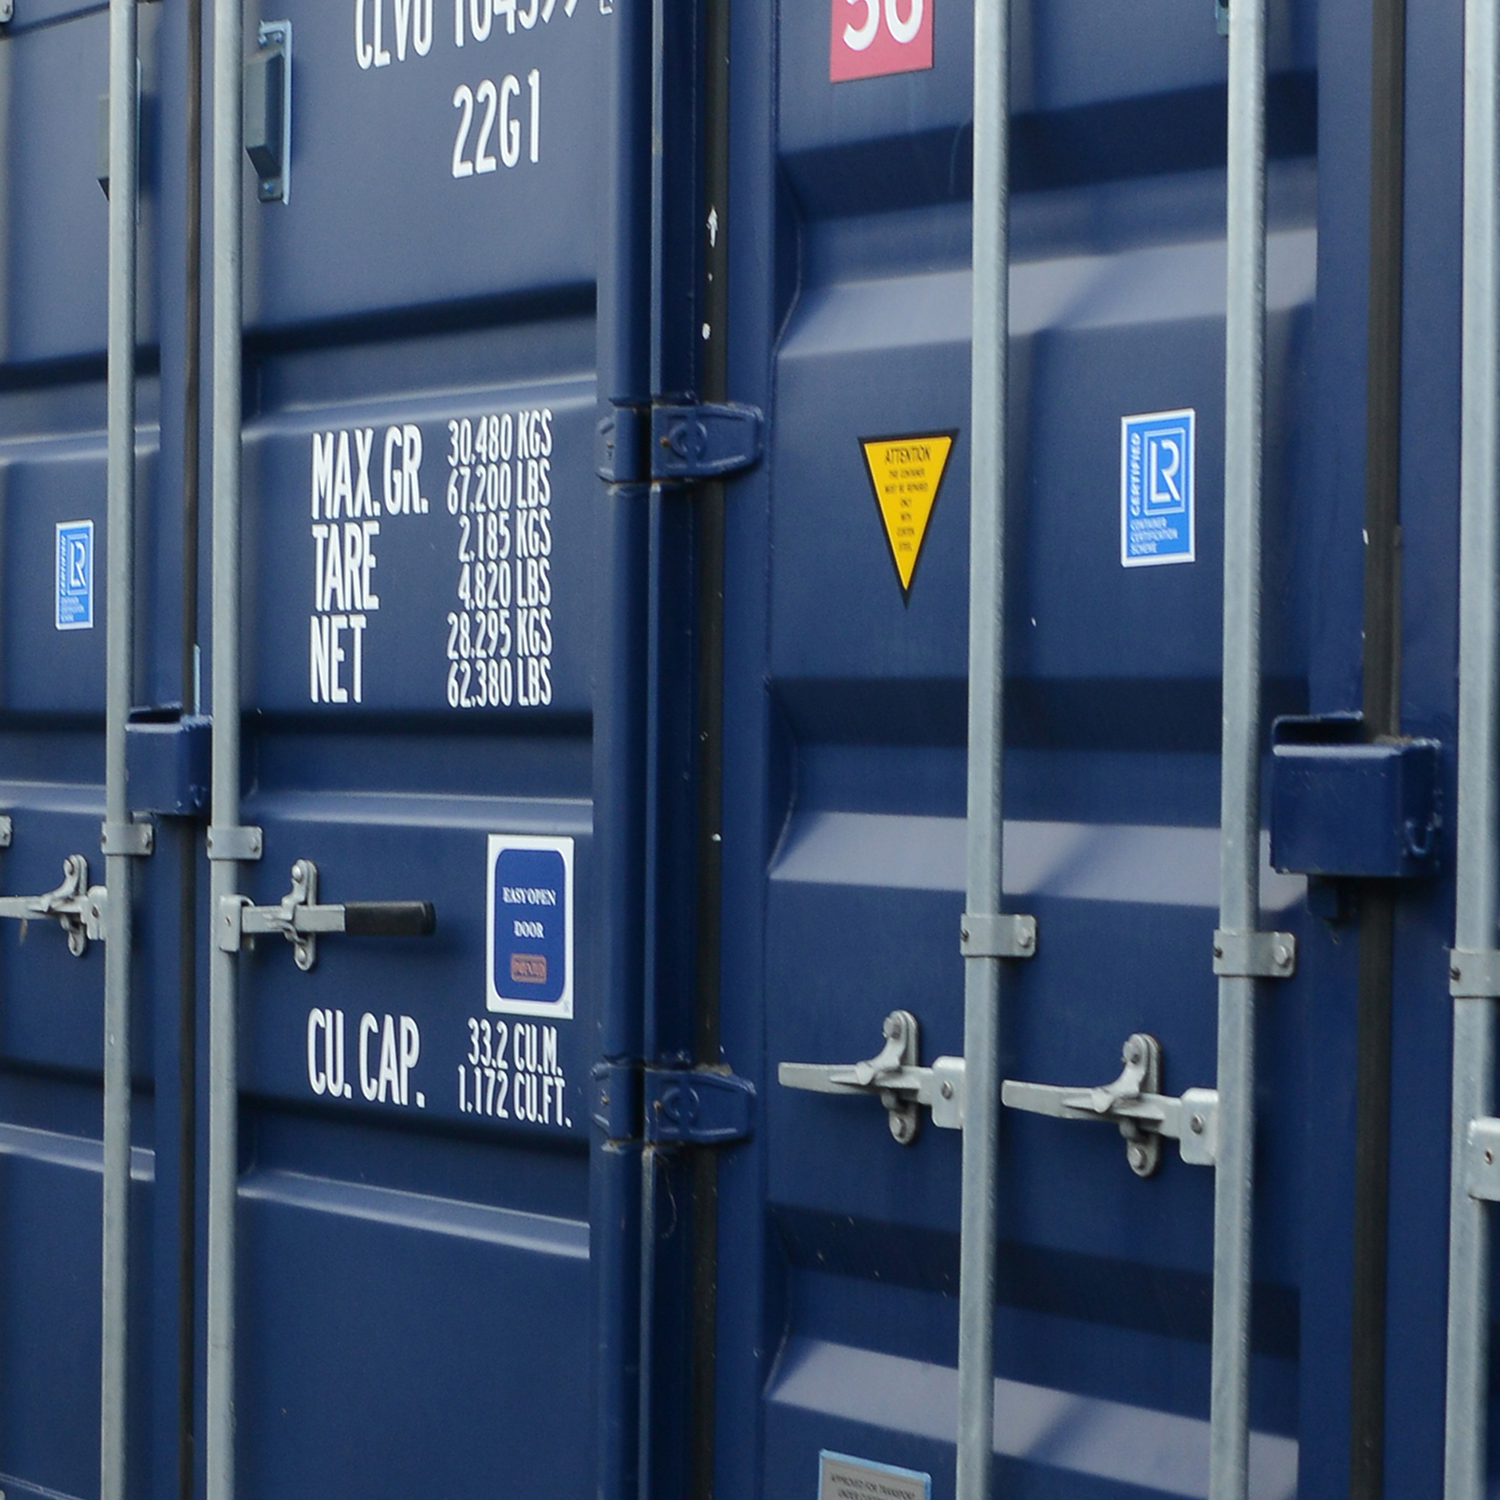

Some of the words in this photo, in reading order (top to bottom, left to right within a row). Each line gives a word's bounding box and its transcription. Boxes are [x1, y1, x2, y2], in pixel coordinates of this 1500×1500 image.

[354, 0, 434, 70] CLVU
[451, 68, 541, 179] 22G1
[447, 413, 513, 466] 30.480
[516, 409, 553, 460] KGS
[885, 445, 932, 465] ATTENTION
[447, 464, 512, 514] 67.200
[516, 458, 553, 509] LBS
[1130, 432, 1141, 517] CERTIFIED
[311, 520, 381, 612] TARE
[457, 514, 512, 564] 2.185
[515, 508, 553, 558] KGS
[457, 562, 512, 612] 4.820
[516, 558, 552, 609] LBS
[310, 614, 367, 704] NET
[447, 611, 512, 661] 28.295
[515, 608, 553, 658] KGS
[447, 659, 513, 709] 62.380
[516, 656, 553, 707] LBS
[514, 920, 545, 939] DOOR
[359, 1012, 426, 1109] CAP.
[467, 1017, 509, 1071] 33.2
[513, 1022, 564, 1077] CU.M.
[457, 1064, 509, 1119] 1.172
